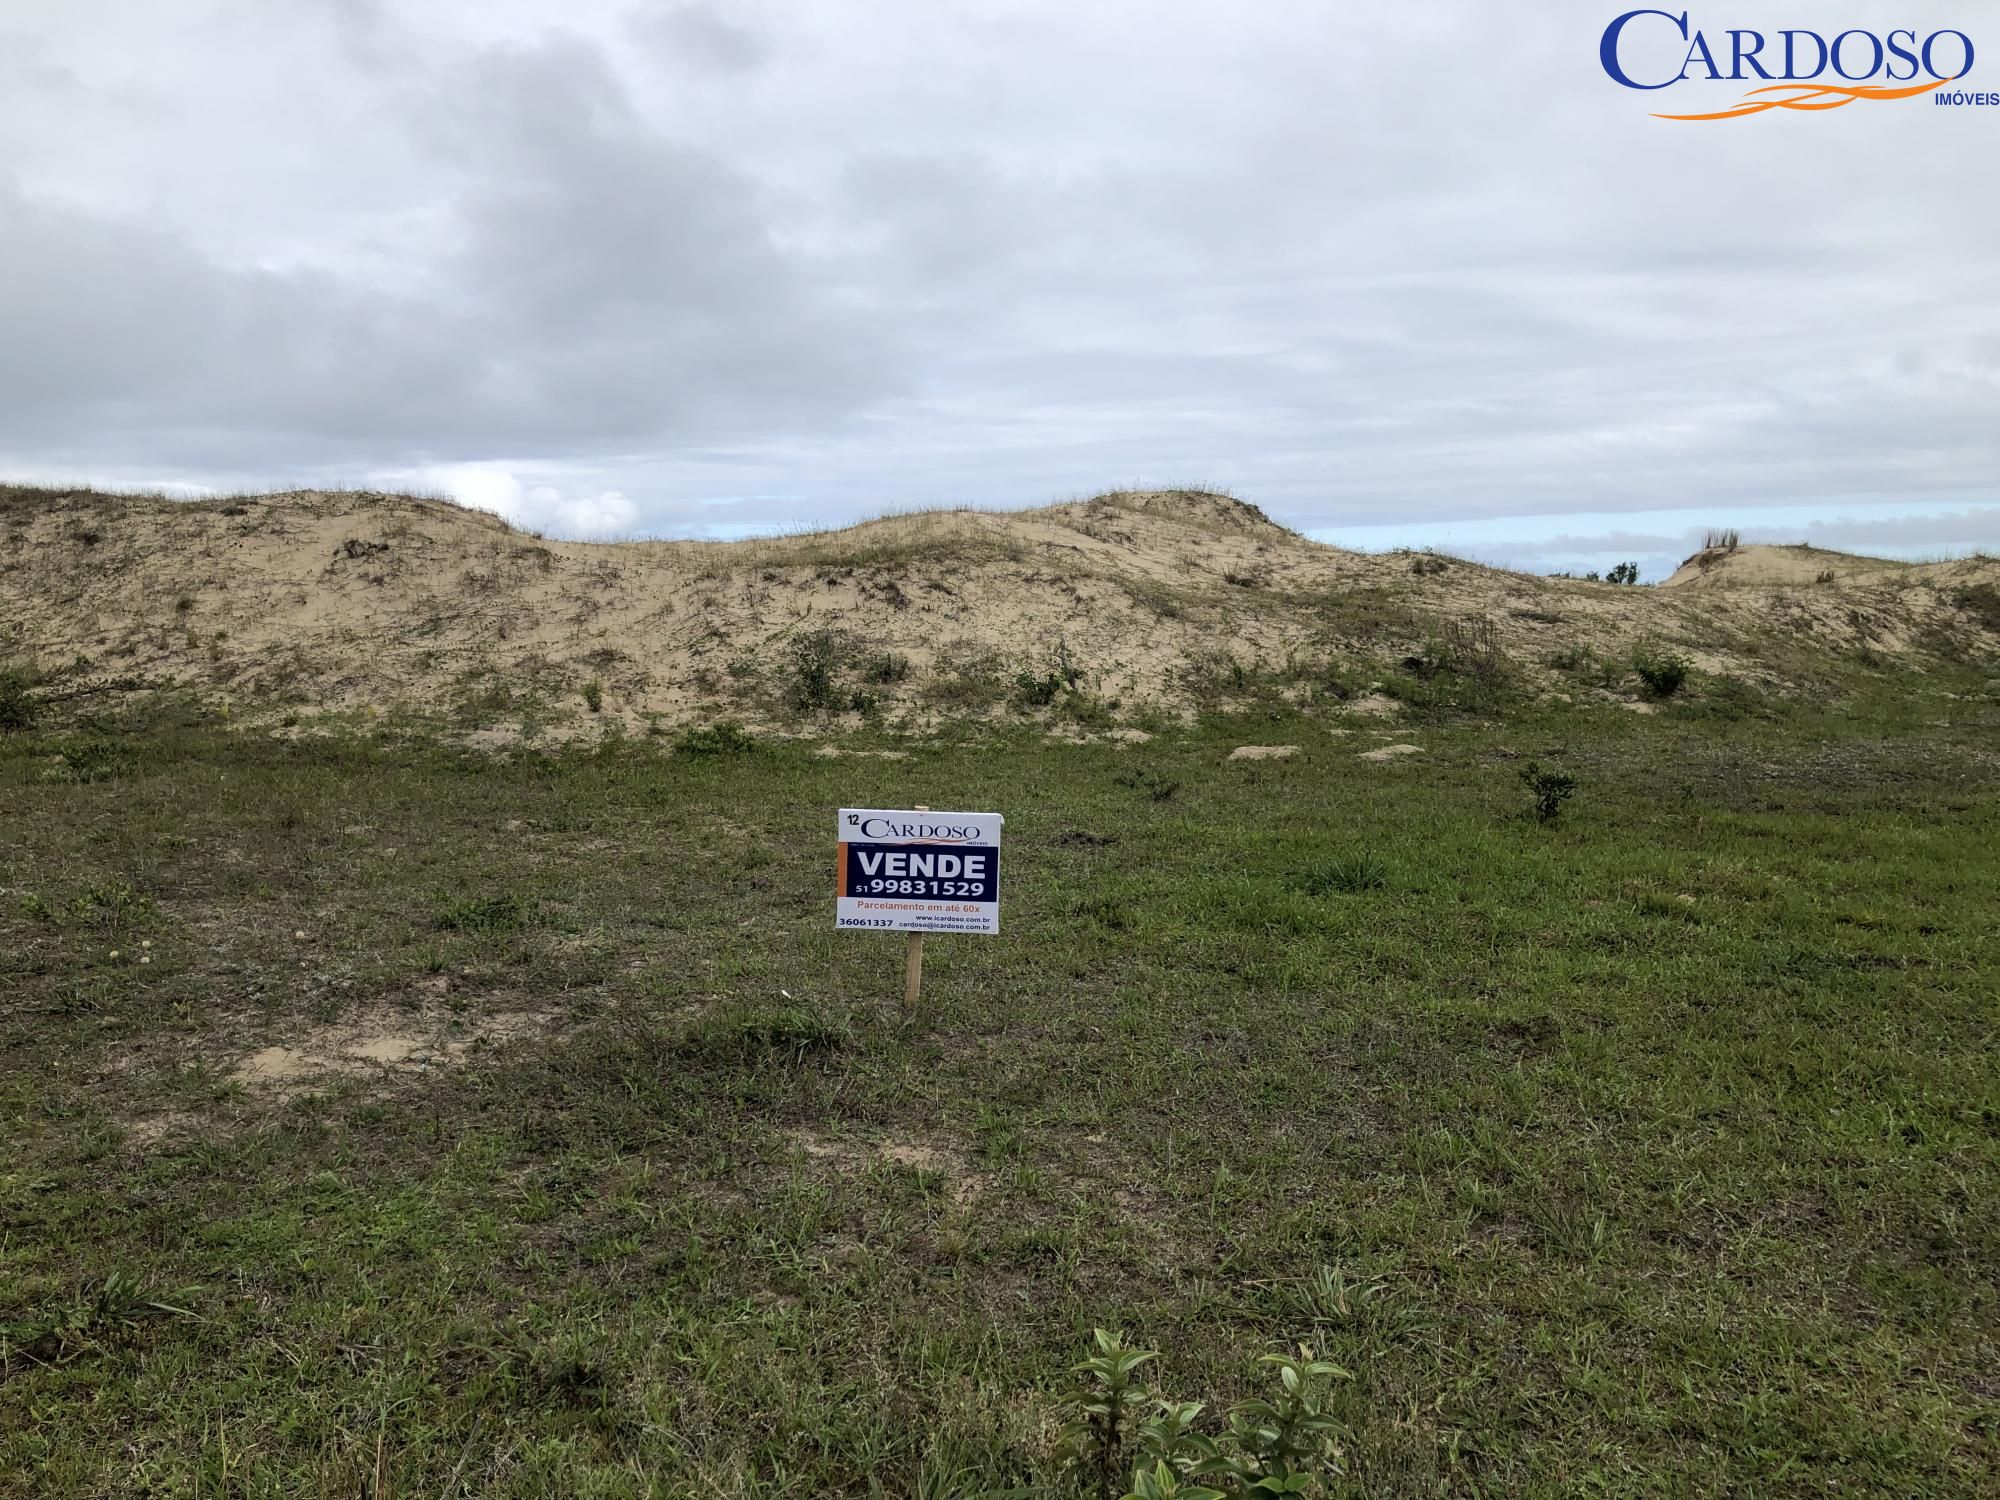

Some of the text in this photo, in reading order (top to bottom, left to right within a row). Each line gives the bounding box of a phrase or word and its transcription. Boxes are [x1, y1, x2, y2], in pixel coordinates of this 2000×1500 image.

[847, 814, 860, 826] 12
[860, 818, 981, 840] CARDOSO
[856, 851, 987, 880] VENDE
[855, 878, 985, 897] 51 99831529
[857, 900, 925, 912] Parcelamento
[945, 904, 961, 913] até
[962, 905, 981, 913] 60x
[839, 918, 894, 928] 36061337
[915, 915, 991, 924] www.icardoso.com.br
[898, 921, 991, 931] cardoso@icardoso.com.br
